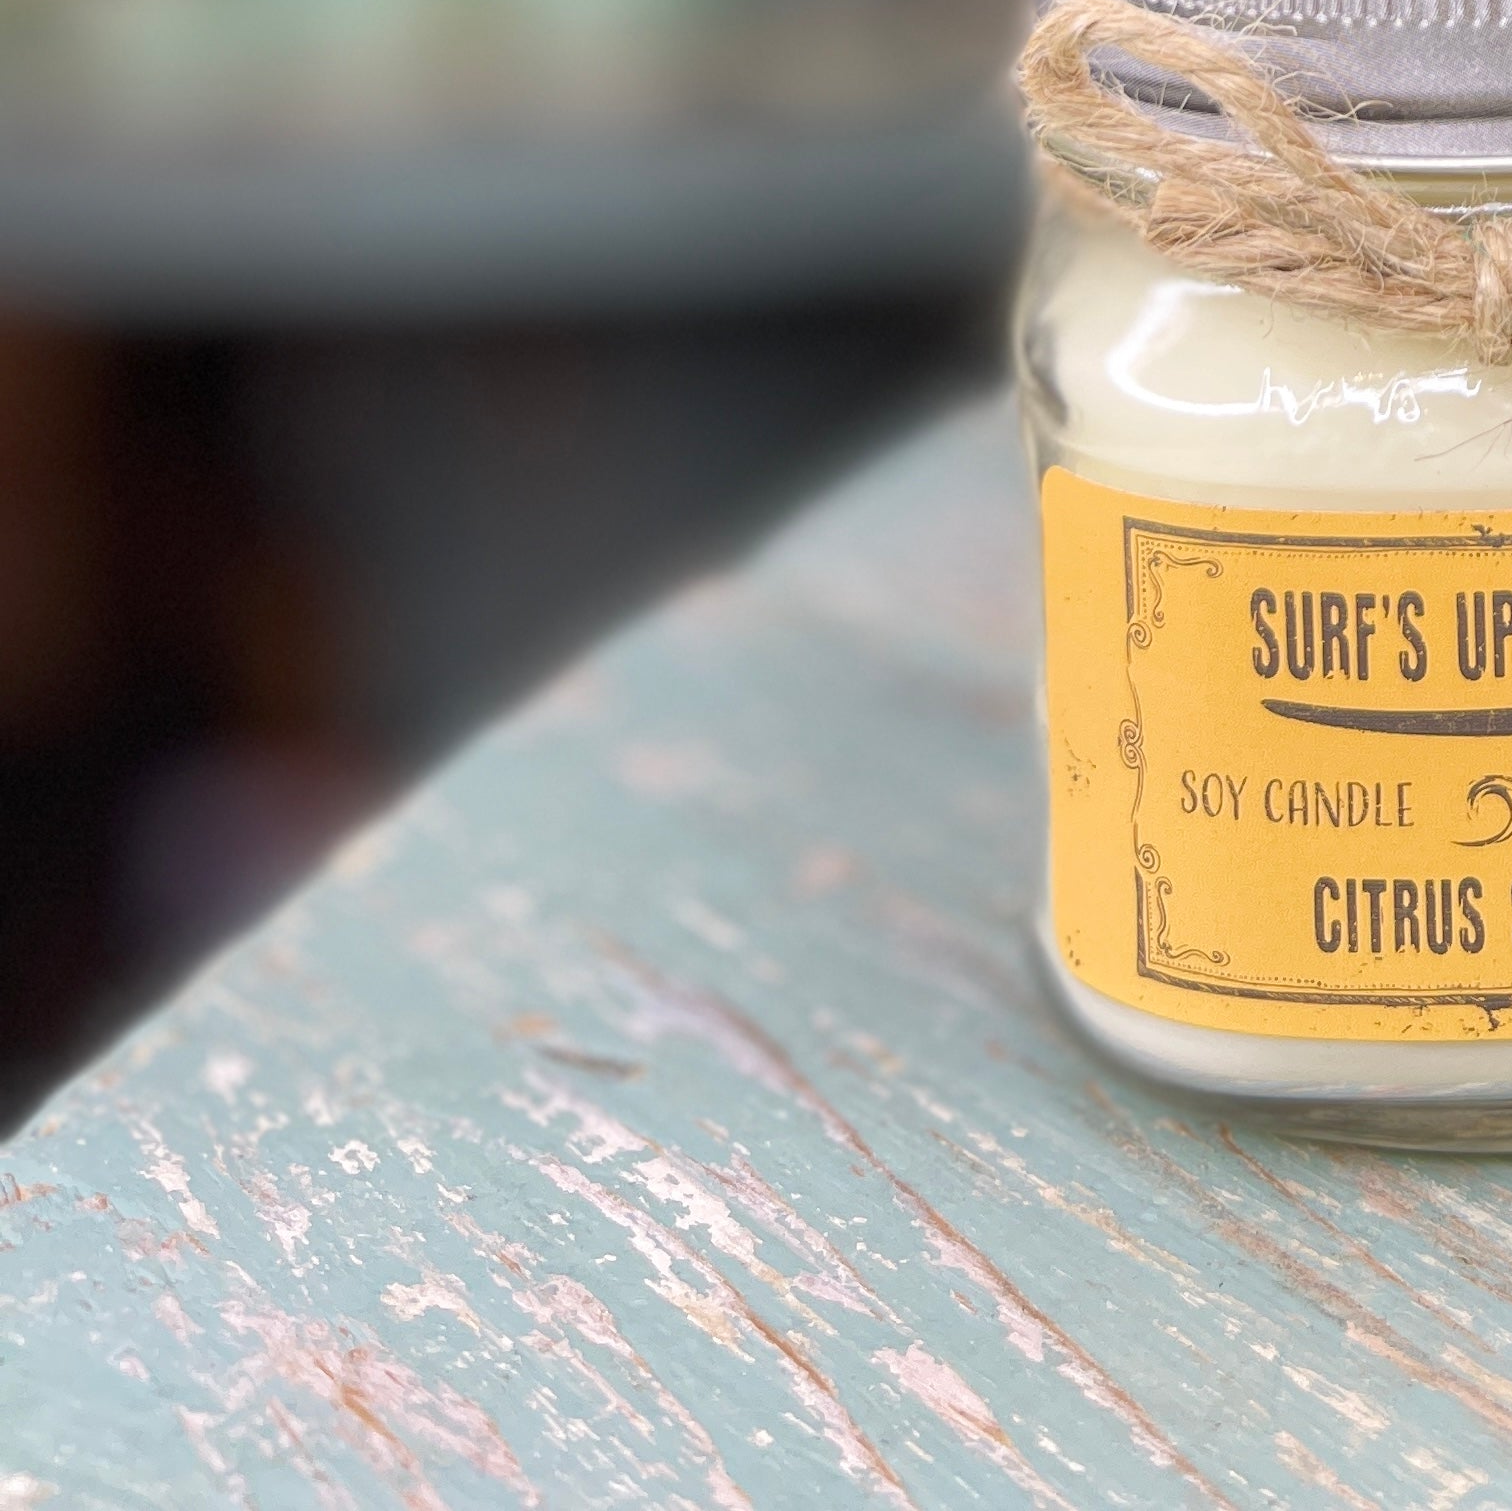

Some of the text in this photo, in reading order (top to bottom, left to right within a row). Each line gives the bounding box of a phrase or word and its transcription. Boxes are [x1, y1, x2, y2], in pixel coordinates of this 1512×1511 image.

[1249, 586, 1428, 683] SURF'S
[1180, 768, 1415, 828] SOY CANDLE
[1313, 875, 1486, 955] CITRUS
